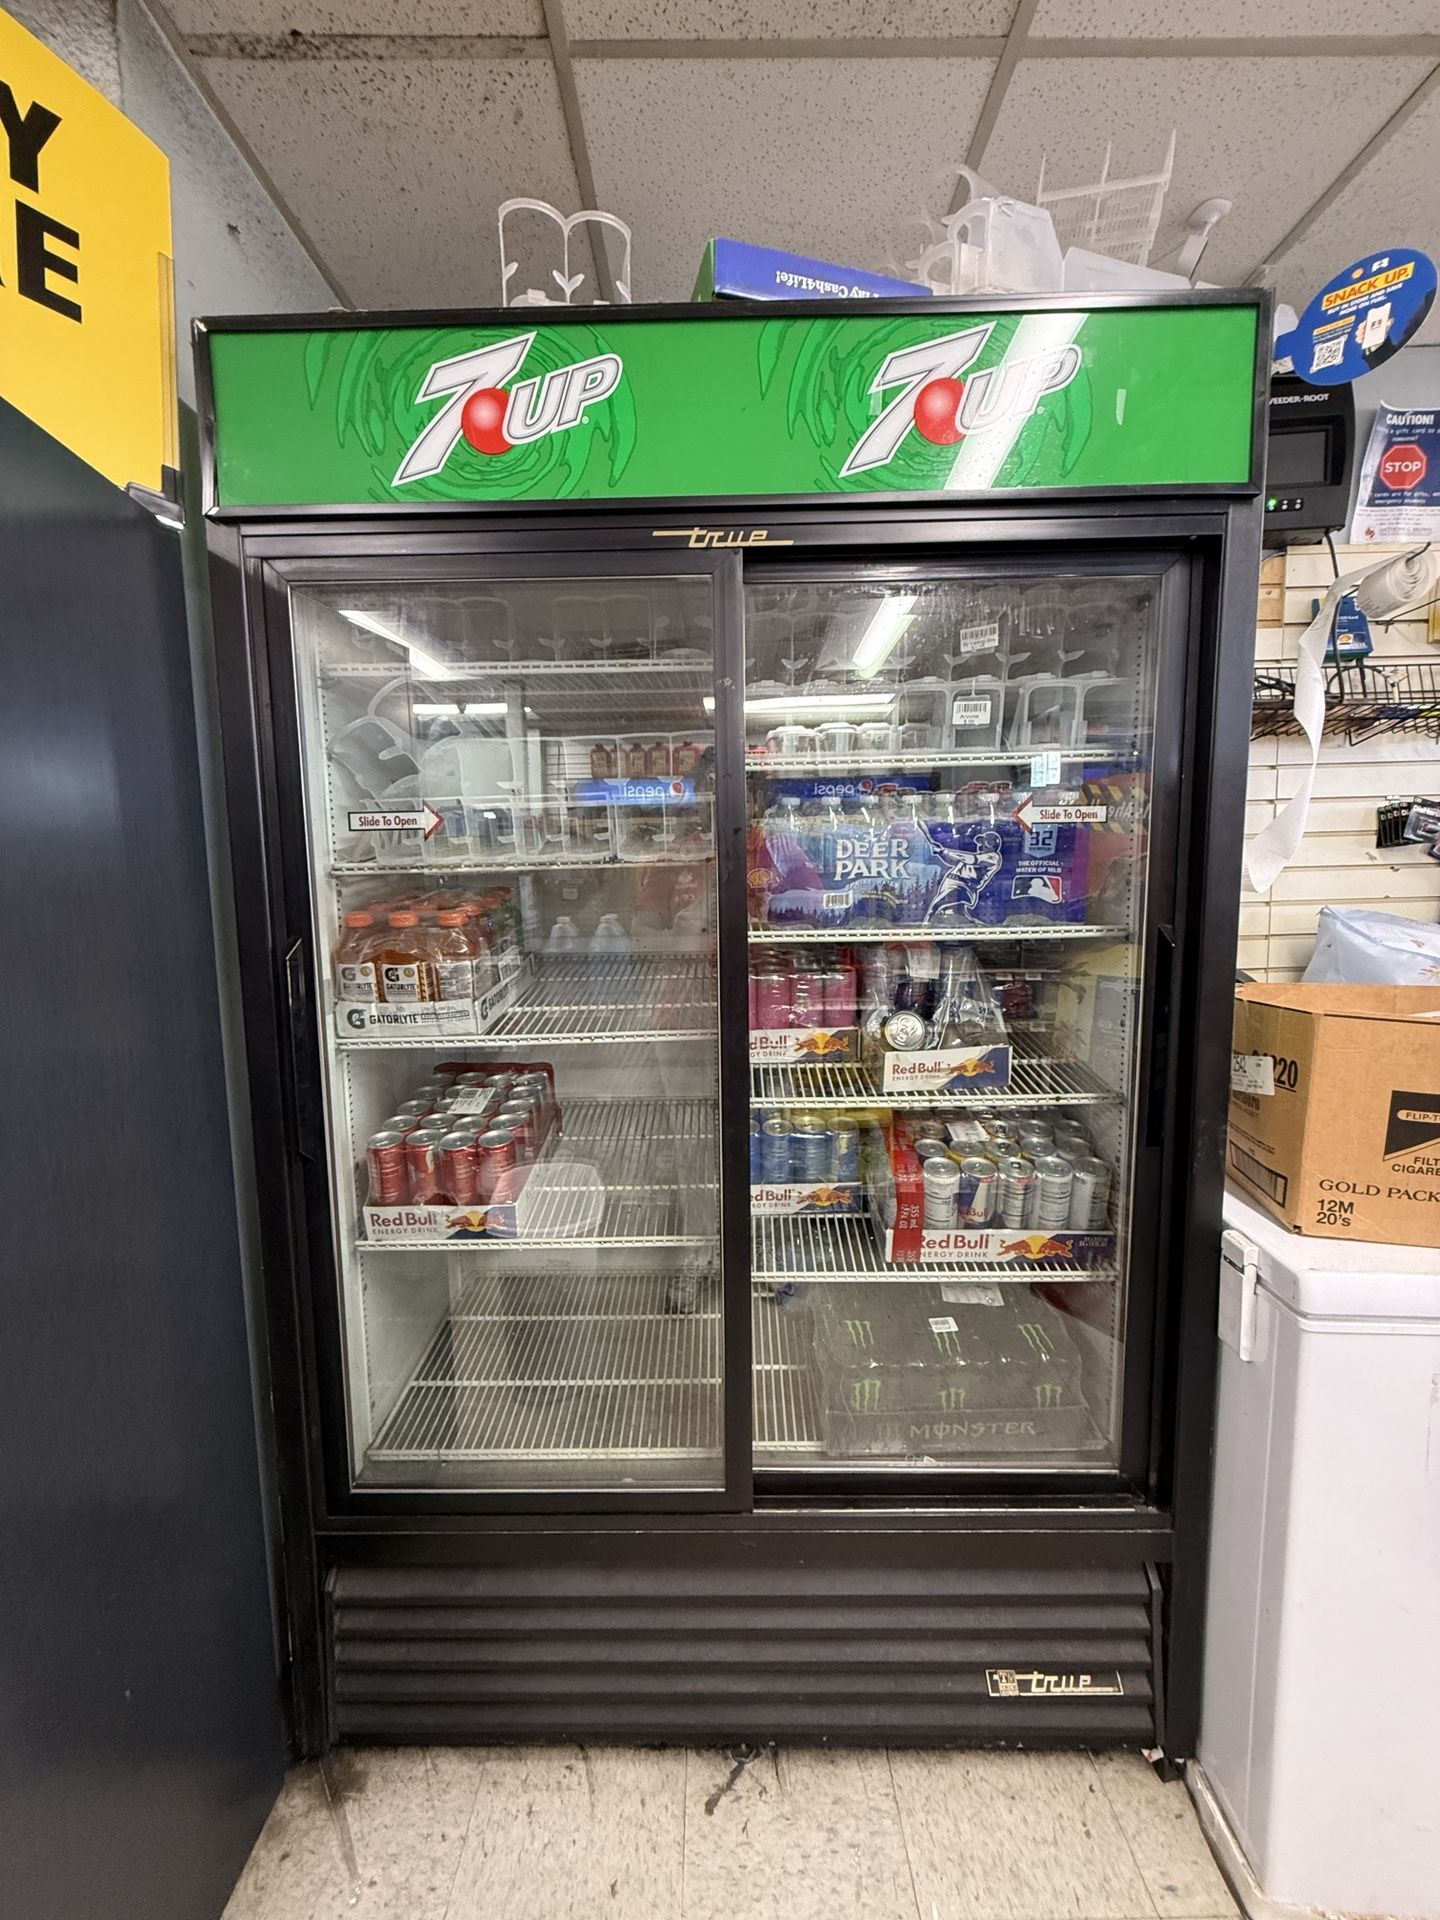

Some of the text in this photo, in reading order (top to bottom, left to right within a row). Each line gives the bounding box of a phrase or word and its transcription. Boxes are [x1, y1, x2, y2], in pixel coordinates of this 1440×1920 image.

[0, 199, 83, 324] E
[775, 270, 849, 298] Cash4Life!
[1324, 267, 1409, 308] SNACK UP.
[839, 320, 1083, 478] 7UP
[392, 331, 623, 486] 7UP
[1386, 413, 1435, 425] CAUTION!
[1384, 461, 1421, 473] STOP
[652, 527, 794, 548] true
[358, 815, 417, 828] Slide To Open
[1040, 808, 1098, 821] Slide To Open
[1030, 830, 1053, 846] 32
[836, 839, 910, 858] DEER
[834, 859, 910, 880] PARK
[369, 1013, 419, 1024] GATORLYTE
[760, 1035, 787, 1049] Bull
[892, 1061, 941, 1075] Red Bull
[1406, 1112, 1440, 1122] FLIP-T
[1392, 1163, 1440, 1176] CIGARE
[766, 1189, 792, 1201] Bull
[1319, 1179, 1440, 1203] GOLD PACK
[1317, 1199, 1354, 1214] 12M
[370, 1211, 437, 1227] Red Bull
[1316, 1211, 1351, 1227] 20's
[953, 1234, 990, 1249] Bull
[993, 1671, 1119, 1693] true
